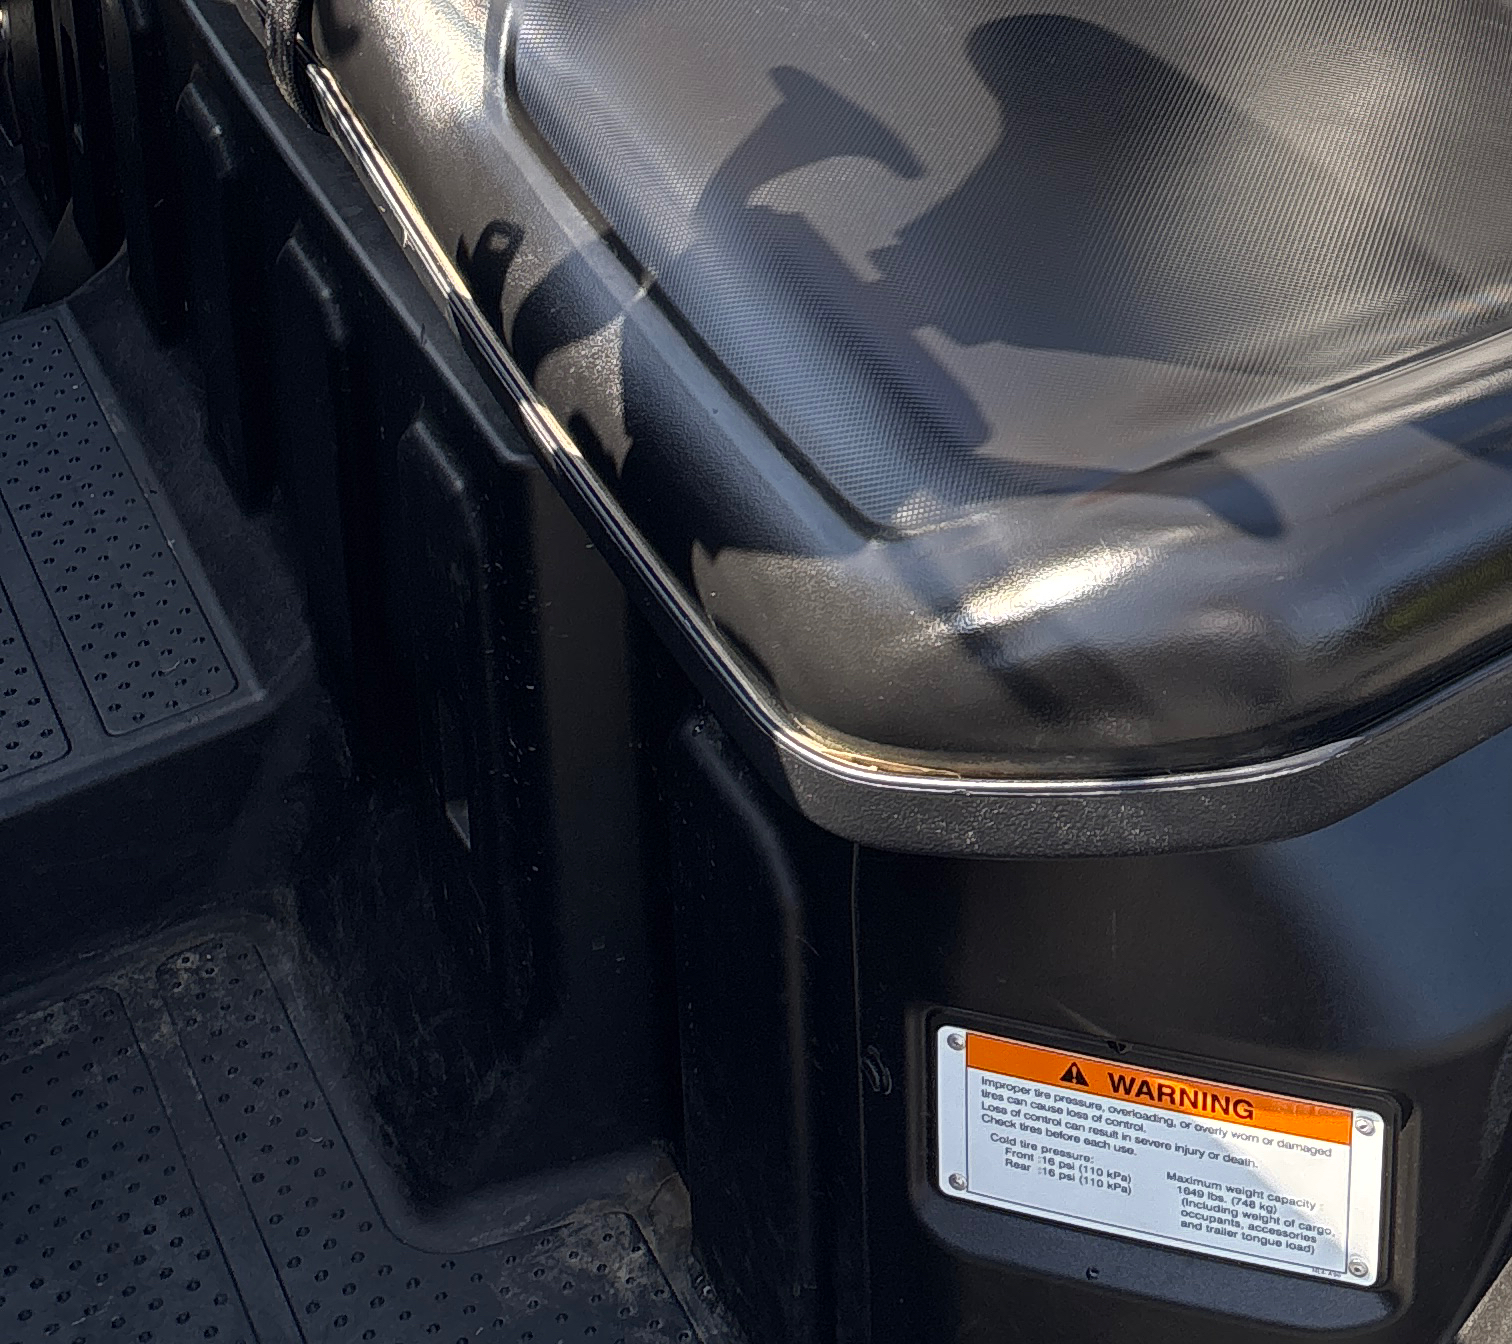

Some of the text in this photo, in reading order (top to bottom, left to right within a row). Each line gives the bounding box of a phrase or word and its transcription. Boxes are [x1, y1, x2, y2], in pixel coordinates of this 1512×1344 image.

[982, 1089, 1147, 1133] tires can cause loss of control.
[1107, 1071, 1254, 1121] WARNING
[981, 1101, 1258, 1169] Loss of control can result in severe injury or death.
[981, 1113, 1137, 1157] Check tires before each use.
[982, 1076, 1332, 1157] Improper tire pressure, overloading, or overly worn or damaged
[990, 1132, 1095, 1165] Cold tire pressure:
[1005, 1147, 1035, 1162] Front
[1058, 1160, 1075, 1171] psi
[1078, 1163, 1104, 1178] (110
[1106, 1169, 1132, 1185] kPa)
[1005, 1158, 1031, 1172] Rear
[1058, 1170, 1075, 1182] psi
[1078, 1174, 1104, 1189] (110
[1106, 1180, 1132, 1196] kPa)
[1166, 1171, 1222, 1191] Maximum
[1225, 1184, 1264, 1200] weight
[1267, 1193, 1316, 1211] capacity
[1207, 1191, 1228, 1204] lbs.
[1259, 1201, 1277, 1215] kg)
[1180, 1209, 1317, 1244] occupants, accessories
[1180, 1219, 1315, 1255] and trailer tongue load)
[1242, 1209, 1281, 1225] weight
[1283, 1217, 1296, 1228] of
[1298, 1221, 1335, 1238] cargo,
